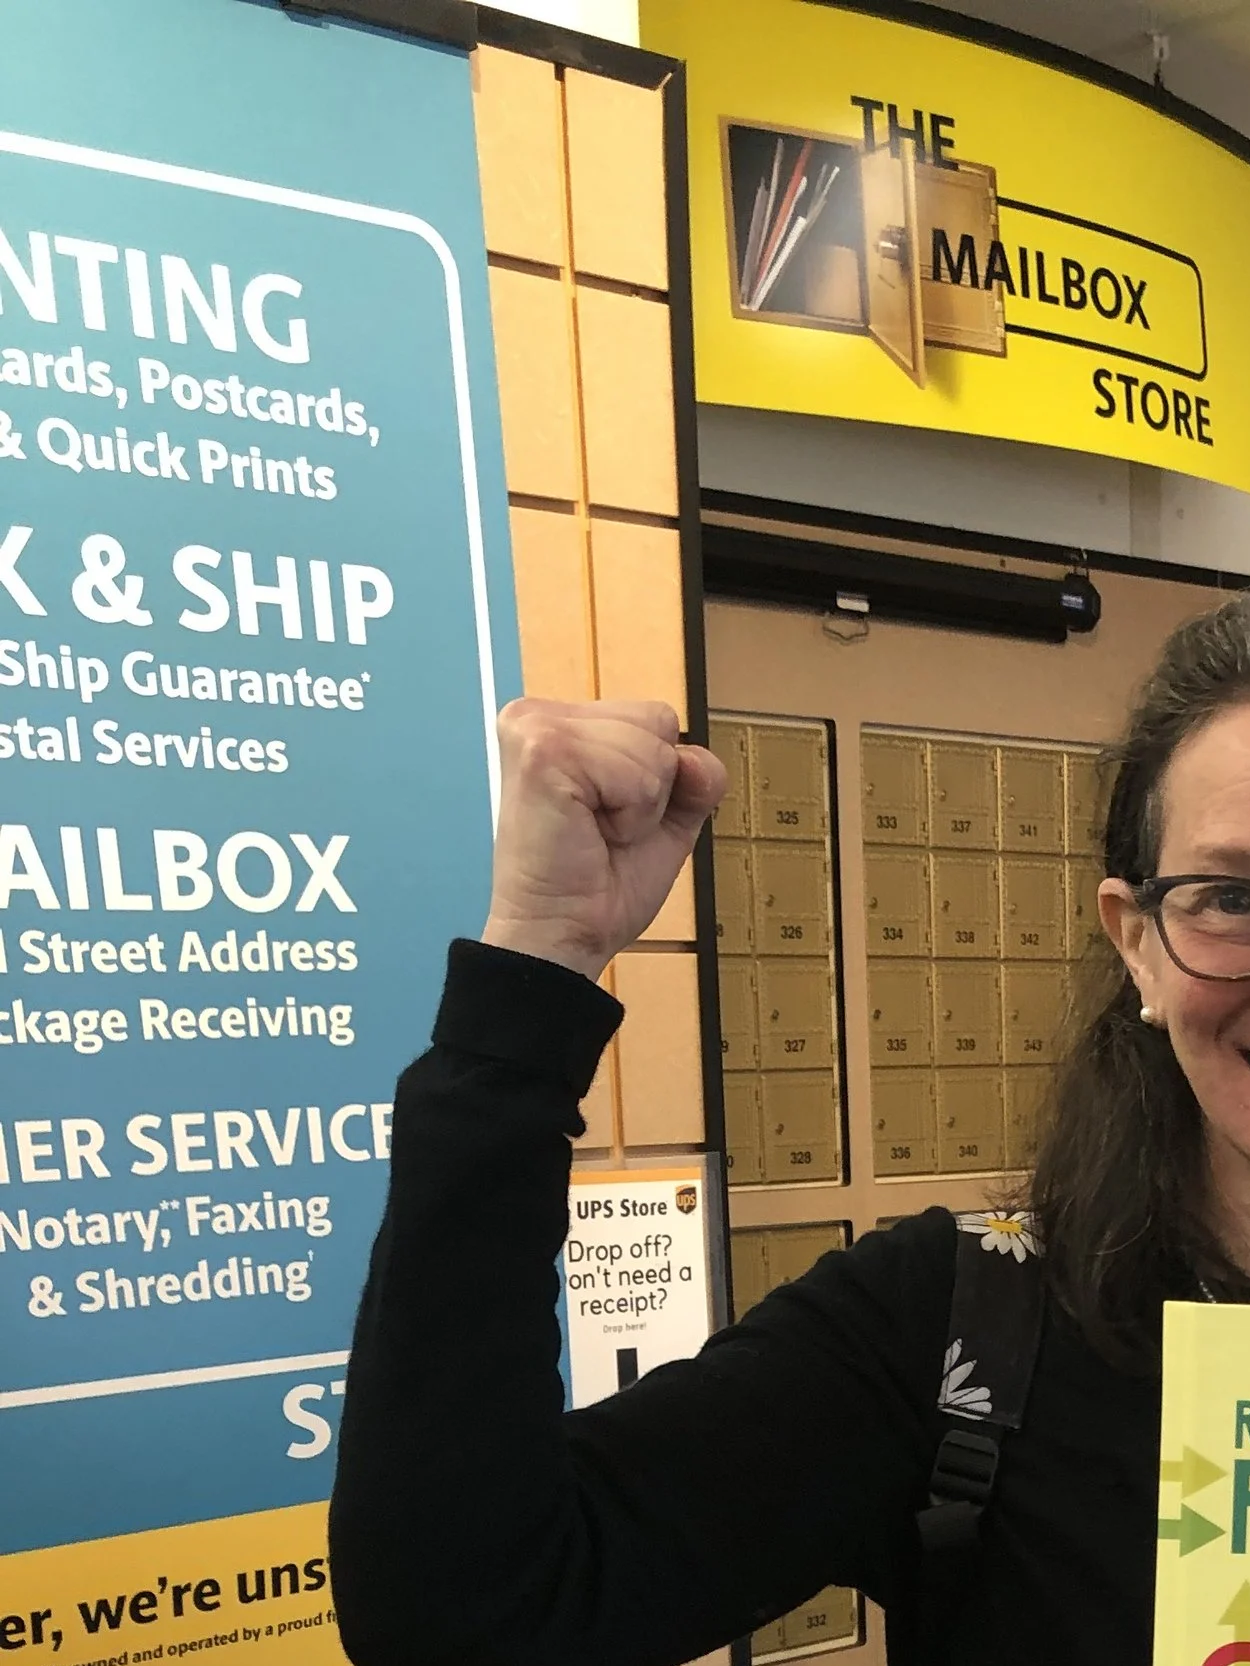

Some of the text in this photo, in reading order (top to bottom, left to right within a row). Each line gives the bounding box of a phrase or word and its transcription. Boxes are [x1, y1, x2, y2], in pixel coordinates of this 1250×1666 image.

[850, 94, 961, 171] THE
[931, 227, 1152, 332] MAILBOX
[0, 346, 380, 446] ards, Postcards,
[1093, 367, 1214, 447] STORE
[37, 417, 190, 482] Quick
[199, 438, 338, 500] Prints
[71, 533, 154, 627] &
[172, 544, 395, 646] SHIP
[0, 640, 108, 704] Ship
[92, 719, 289, 773] Services
[776, 811, 799, 825] 325
[877, 815, 897, 829] 333
[950, 820, 971, 833] 337
[1019, 824, 1038, 837] 341
[780, 926, 803, 940] 326
[882, 927, 904, 940] 334
[955, 931, 975, 944] 338
[1020, 933, 1039, 945] 342
[19, 929, 358, 974] Street Address
[139, 996, 355, 1046] Receiving
[784, 1039, 806, 1053] 327
[886, 1039, 907, 1052] 335
[956, 1039, 976, 1052] 339
[790, 1151, 811, 1165] 328
[890, 1147, 911, 1159] 336
[959, 1145, 978, 1157] 340
[186, 1193, 332, 1237] Faxing
[577, 1199, 668, 1219] UPS Store
[568, 1234, 672, 1265] Drop off?
[619, 1261, 671, 1286] need
[679, 1266, 692, 1281] a
[28, 1277, 66, 1318] &
[580, 1288, 667, 1317] receipt?
[282, 1382, 348, 1459] S
[0, 1556, 331, 1652] er, we're uns
[807, 1614, 826, 1628] 332
[132, 1645, 164, 1664] and
[167, 1628, 239, 1657] operated
[243, 1626, 261, 1642] by
[265, 1625, 274, 1637] a
[278, 1612, 322, 1637] proud
